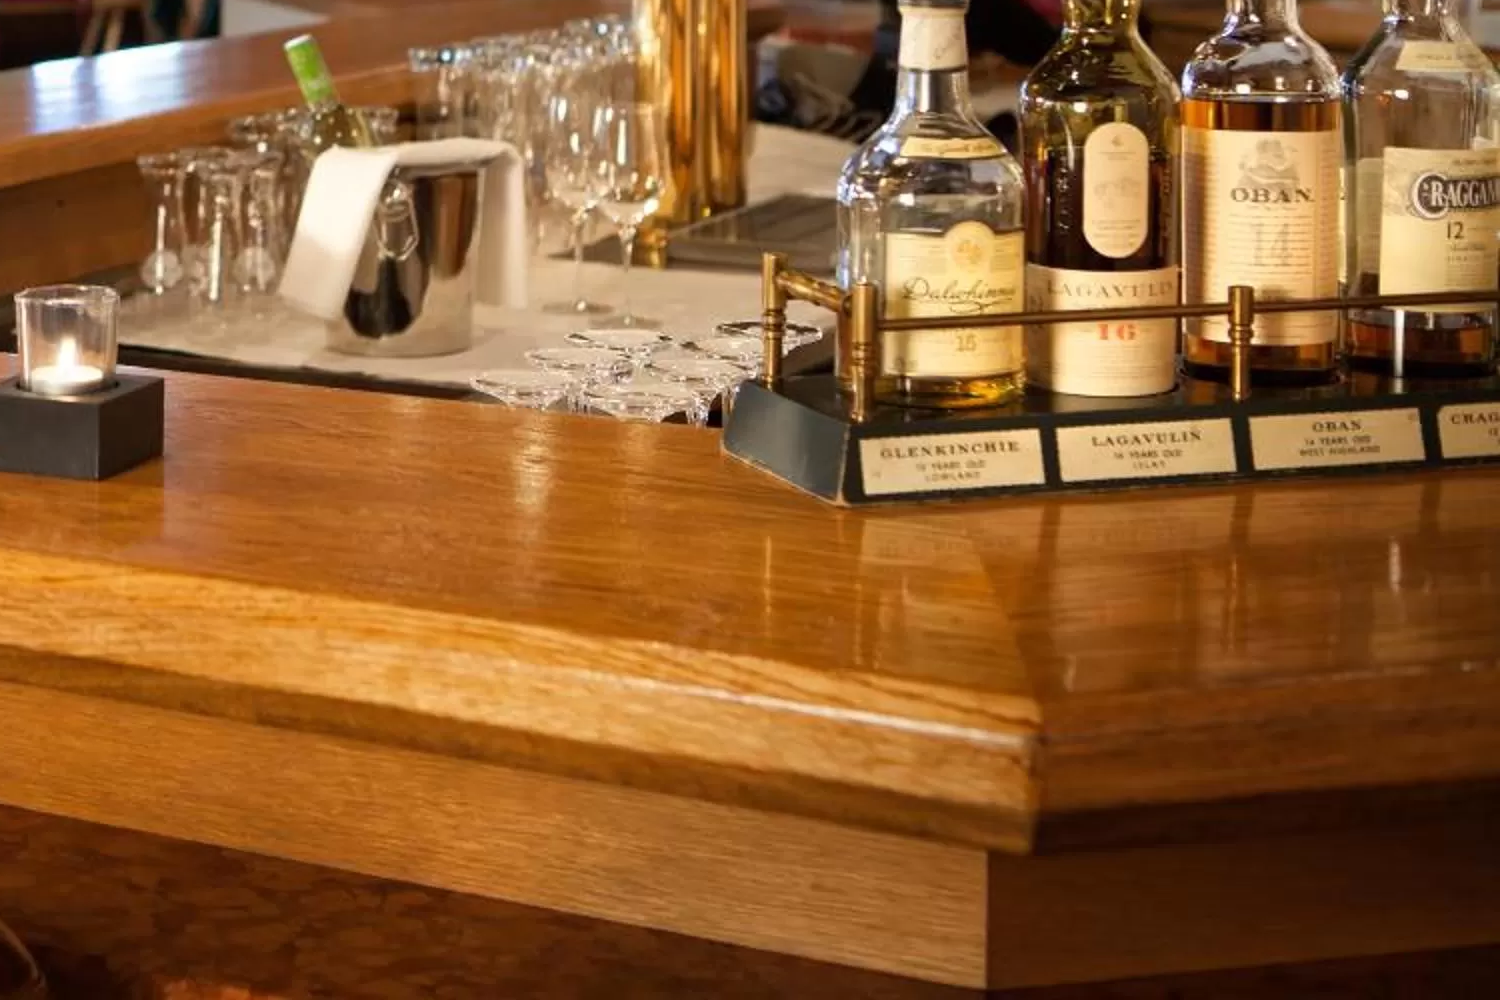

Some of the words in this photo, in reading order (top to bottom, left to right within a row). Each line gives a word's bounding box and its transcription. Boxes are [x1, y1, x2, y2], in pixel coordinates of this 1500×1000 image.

[1230, 187, 1314, 203] OBAN
[1446, 220, 1465, 240] 12
[1253, 222, 1294, 267] 14
[1097, 323, 1137, 342] 16
[1312, 419, 1363, 433] OBAN
[1092, 428, 1203, 448] LAGAVULIN
[1320, 435, 1349, 446] YEARS
[879, 441, 1021, 460] GLENKINCHIE
[1129, 450, 1160, 460] YEARS
[931, 460, 962, 472] YEARS
